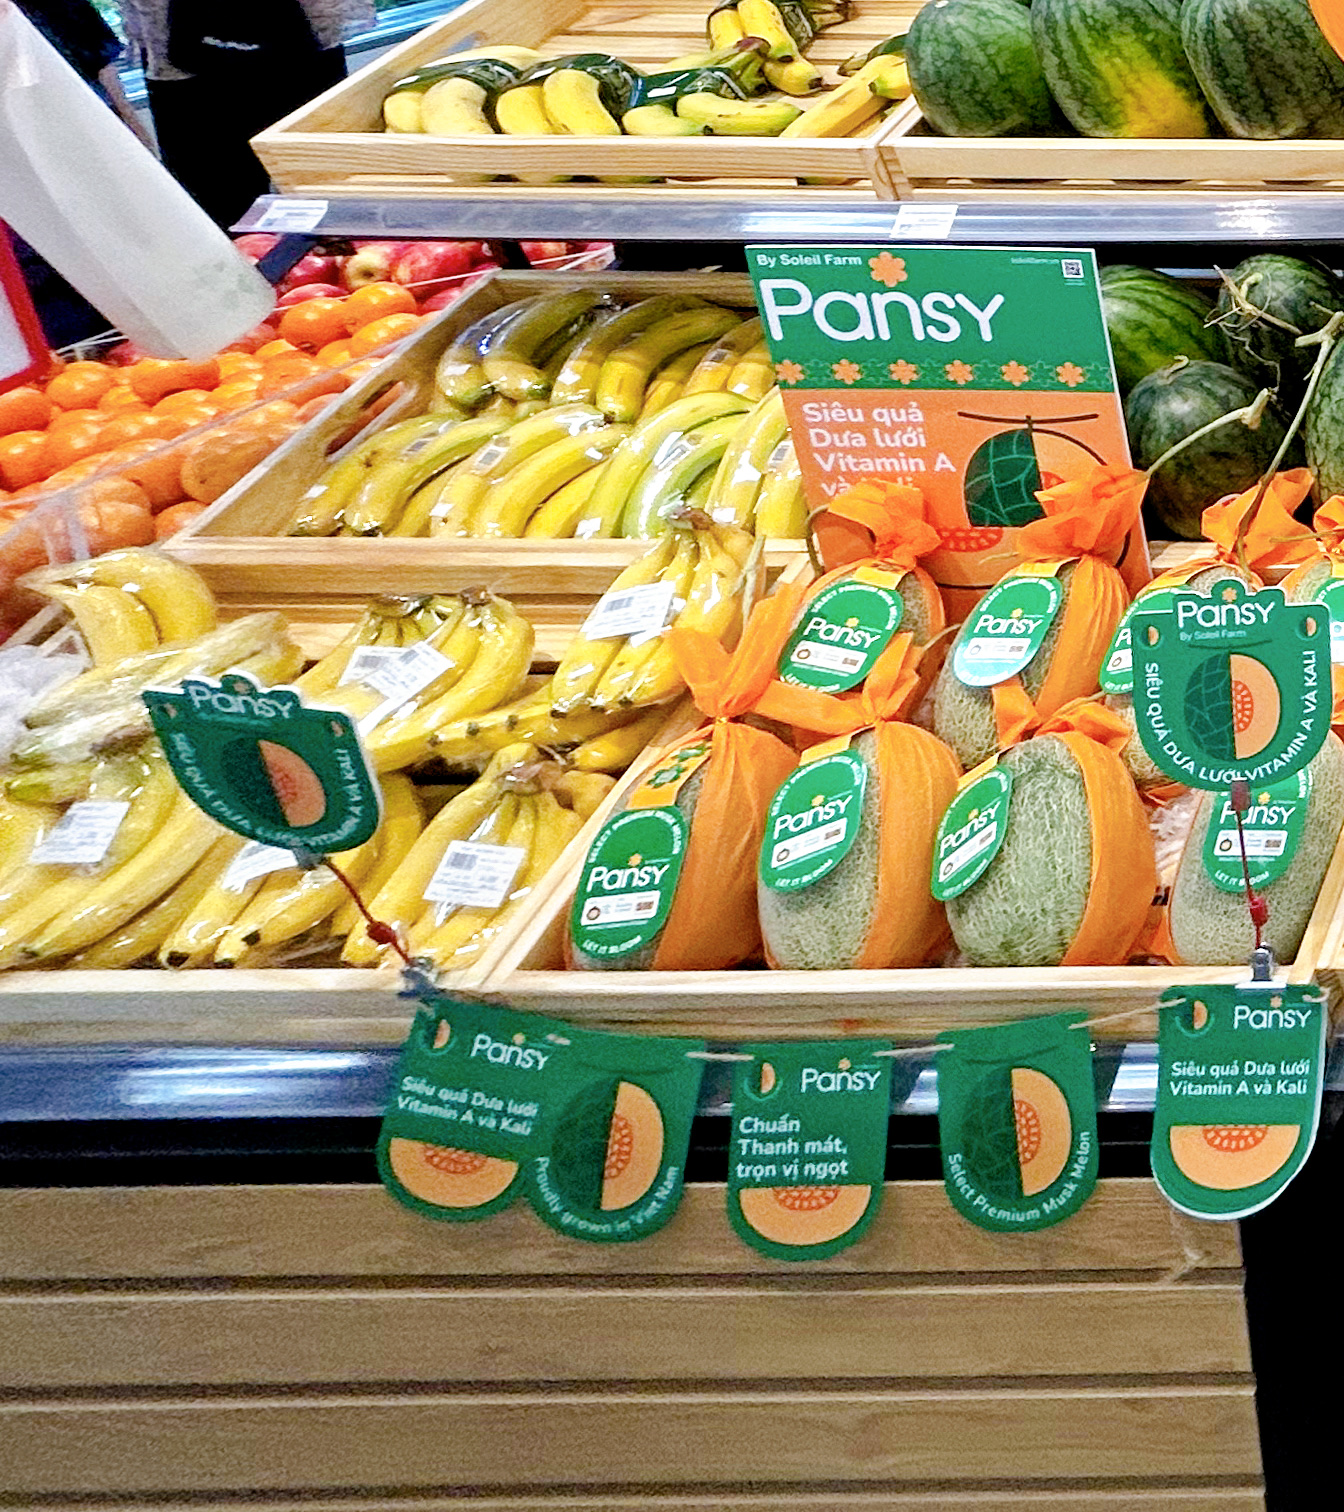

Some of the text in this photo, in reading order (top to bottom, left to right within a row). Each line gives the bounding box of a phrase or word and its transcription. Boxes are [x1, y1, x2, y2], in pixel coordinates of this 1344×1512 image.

[756, 254, 862, 267] By Soleil Farm
[802, 401, 924, 427] Siêu quả
[809, 426, 927, 448] Dưa lưới
[813, 451, 957, 473] Vitamin A
[1304, 650, 1317, 688] KALI
[1145, 662, 1160, 700] SIÊU
[1303, 692, 1319, 715] VÀ
[1299, 718, 1315, 731] A
[1163, 740, 1196, 776] DƯA
[1245, 731, 1309, 781] VITAMIN
[1171, 1059, 1311, 1079] Siêu quả Dưa lưới
[1170, 1078, 1308, 1096] Vitamin A và Kali
[471, 1091, 504, 1112] Dưa
[397, 1095, 532, 1136] Vitamin A và Kali
[738, 1113, 801, 1134] Chuẩn
[737, 1134, 848, 1156] Thanh mát,
[736, 1159, 849, 1182] trọn vị ngọt
[948, 1131, 1091, 1222] Select Premium Musk Melon
[535, 1156, 563, 1214] Proudly
[655, 1166, 680, 1201] Nam
